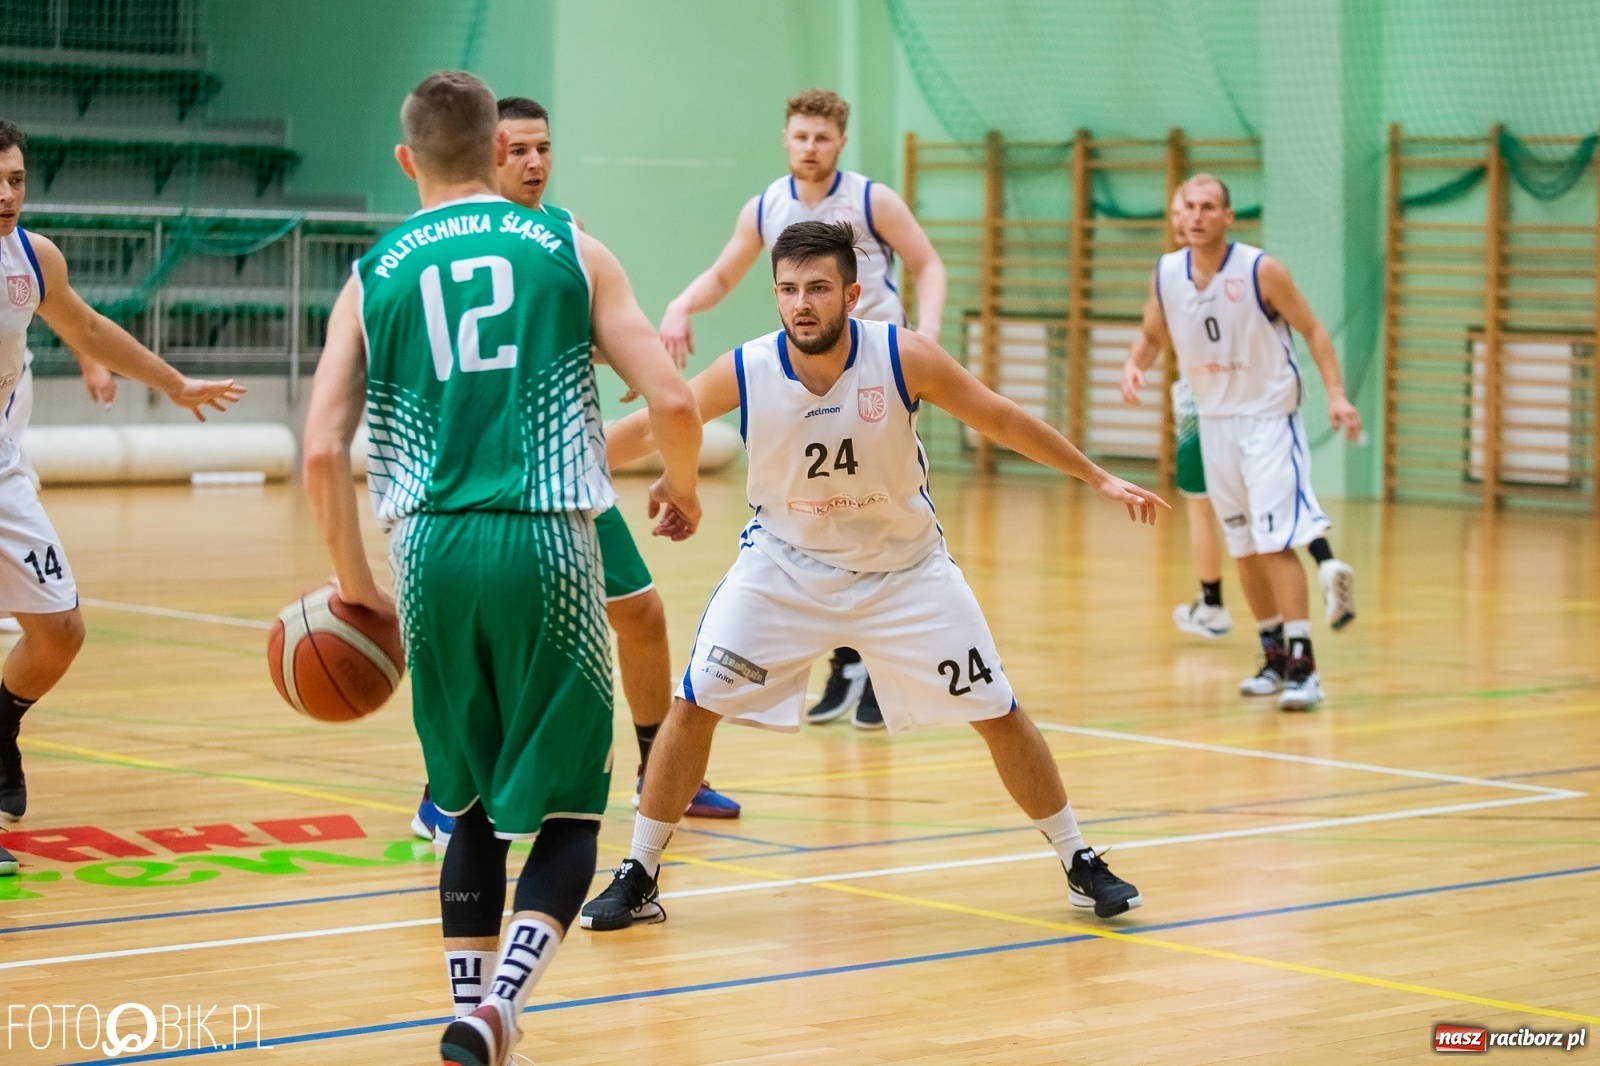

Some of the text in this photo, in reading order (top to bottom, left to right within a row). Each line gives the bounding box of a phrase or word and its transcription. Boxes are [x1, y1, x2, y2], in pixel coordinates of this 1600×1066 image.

[375, 211, 562, 278] POLITECHNIKA ŚLĄSKA
[420, 255, 518, 382] 12
[1204, 316, 1221, 342] 0
[805, 438, 859, 479] 24
[24, 545, 62, 584] 14
[937, 647, 994, 697] 24
[0, 814, 367, 863] AKO
[444, 891, 481, 902] SIWY
